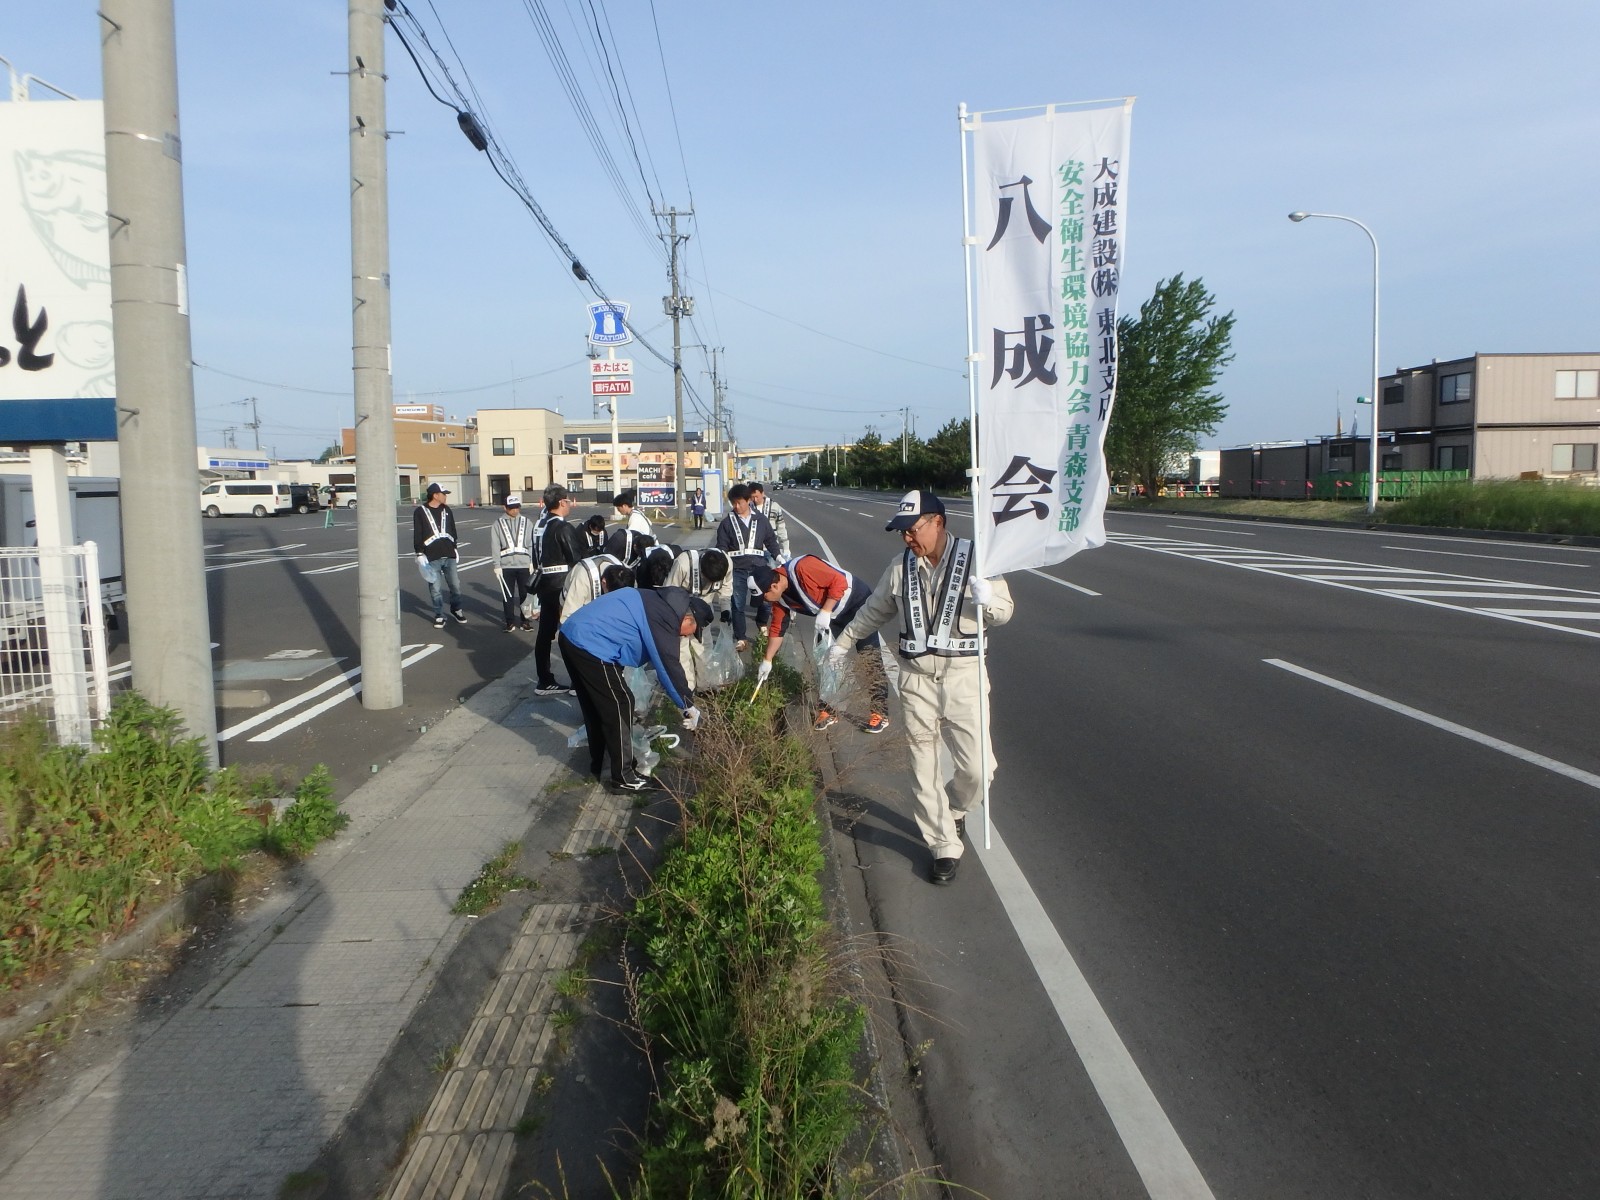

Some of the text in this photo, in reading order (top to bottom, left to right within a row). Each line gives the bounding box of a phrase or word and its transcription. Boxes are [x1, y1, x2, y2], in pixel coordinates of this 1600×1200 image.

[594, 332, 626, 341] STATION
[986, 174, 1058, 527] 八成会
[1058, 160, 1092, 532] 安全衛生環境協力会 青森支部
[594, 383, 629, 393] 銀行ATM
[640, 491, 674, 503] おにぎり
